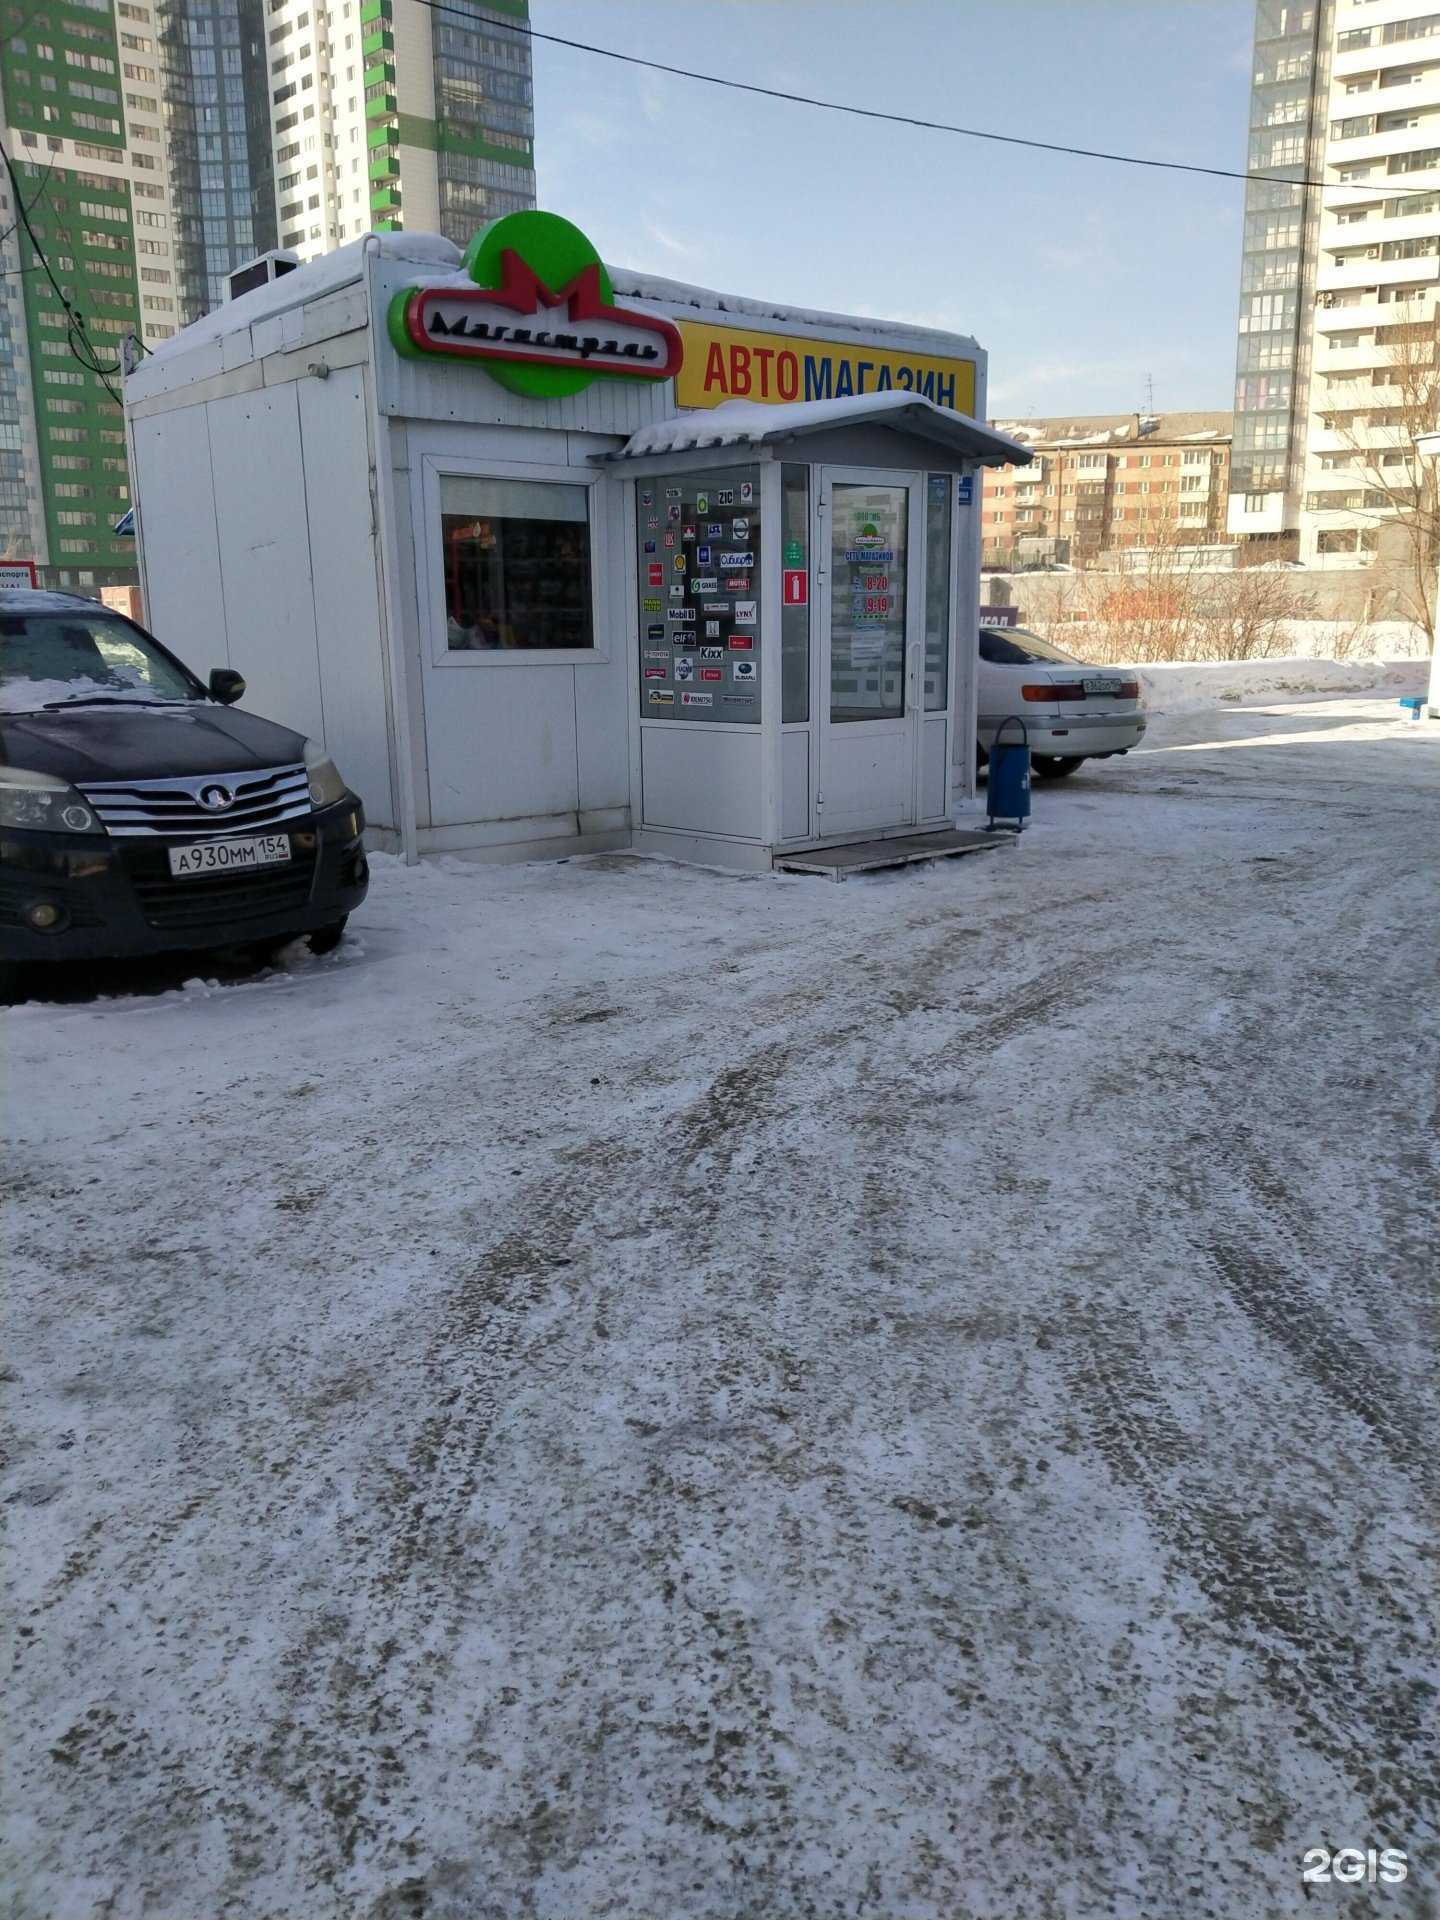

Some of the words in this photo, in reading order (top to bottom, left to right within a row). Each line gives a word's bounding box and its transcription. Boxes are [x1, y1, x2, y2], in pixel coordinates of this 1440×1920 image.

[428, 311, 659, 359] Магистраль
[703, 341, 956, 410] АВТОМАГАЗИН
[719, 491, 733, 505] ZIC
[669, 609, 688, 619] Mobil
[673, 632, 688, 643] elf
[701, 647, 722, 659] Kixx
[259, 837, 286, 854] 154
